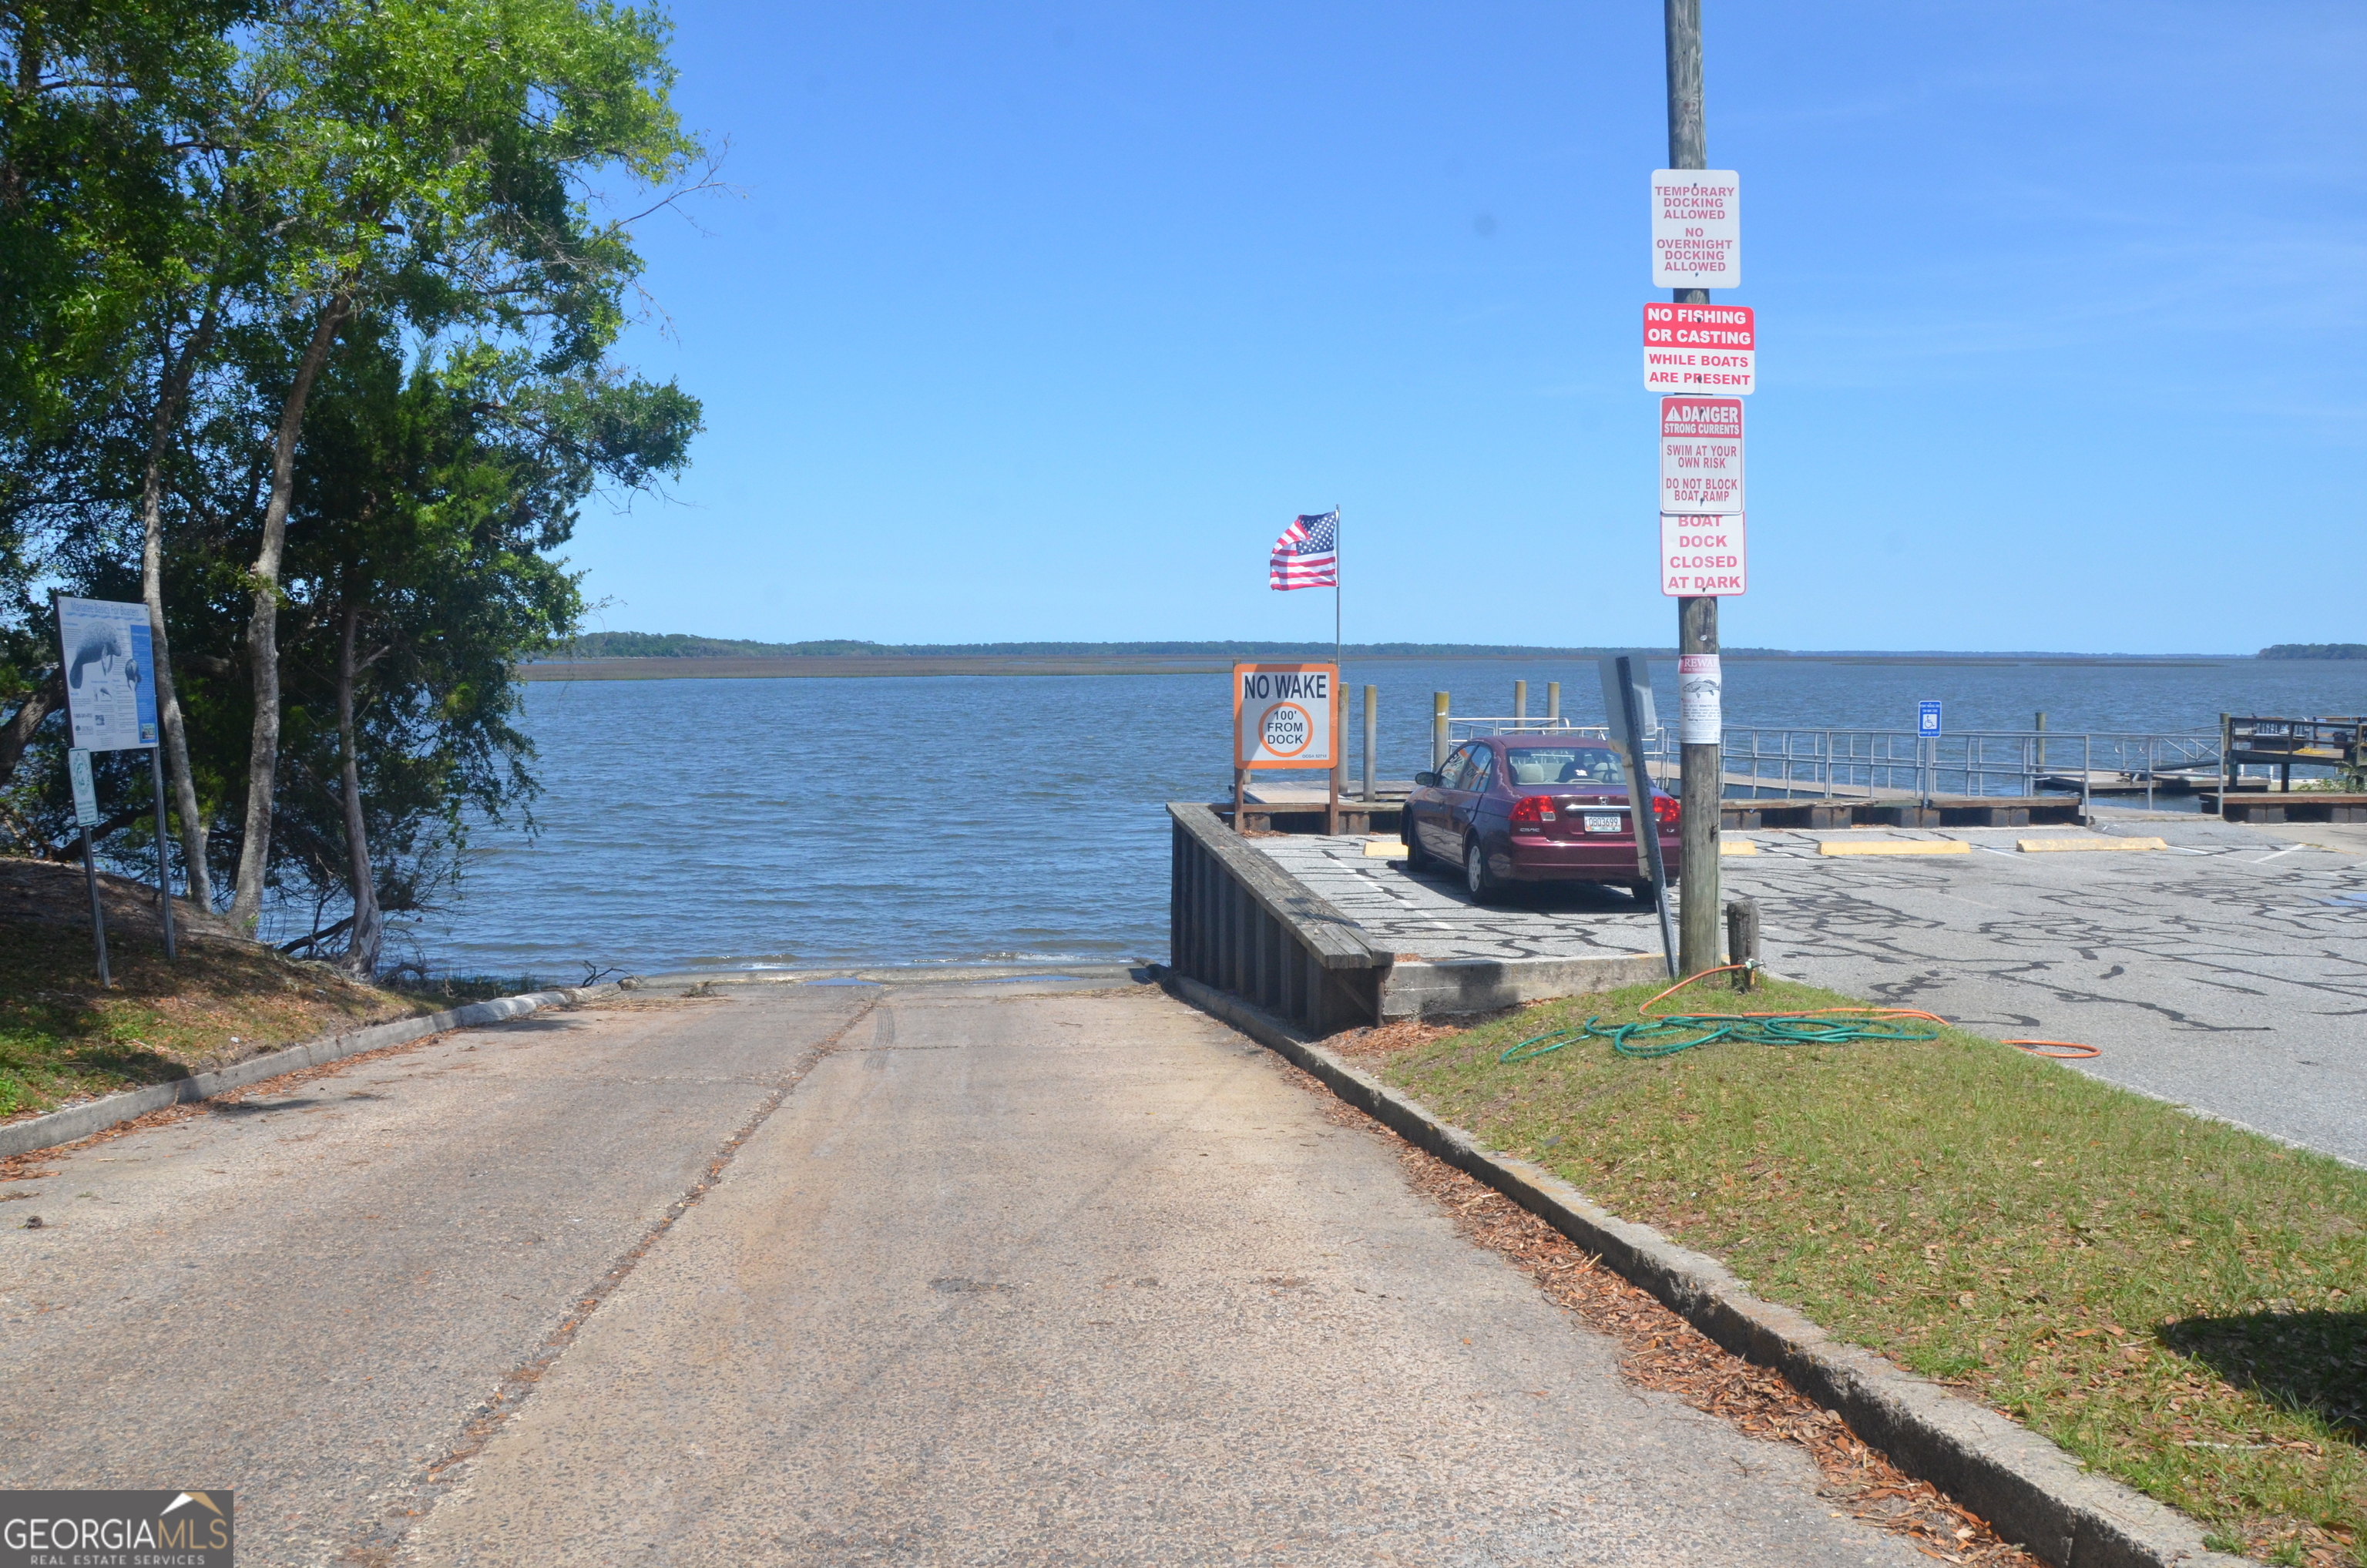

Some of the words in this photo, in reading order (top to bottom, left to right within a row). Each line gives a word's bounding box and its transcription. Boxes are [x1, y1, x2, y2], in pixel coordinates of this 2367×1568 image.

[1655, 186, 1735, 196] TEMPORARY
[1664, 198, 1724, 208] DOCKING
[1664, 210, 1725, 220] ALLOWED
[1685, 228, 1704, 237] NO
[1657, 239, 1732, 249] OVERNIGHT
[1665, 251, 1725, 260] DOCKING
[1664, 262, 1726, 272] ALLOWED
[1648, 308, 1672, 321] NO
[1677, 309, 1746, 325] FISHING
[1648, 328, 1672, 342] OR
[1676, 330, 1751, 345] CASTING
[1649, 353, 1696, 365] WHILE
[1701, 356, 1749, 367] BOATS
[1649, 372, 1679, 383] ARE
[1684, 373, 1750, 385] PRESENT
[1682, 406, 1739, 423] DANGER
[1664, 423, 1696, 434] STRONG
[1698, 424, 1739, 435] CURRENTS
[1667, 445, 1692, 456] SWIM
[1696, 445, 1707, 456] AT
[1711, 446, 1737, 457] YOUR
[1678, 457, 1700, 468] OWN
[1703, 457, 1726, 468] RISK
[1666, 478, 1679, 489] DO
[1683, 478, 1702, 489] NOT
[1706, 478, 1737, 490] BLOCK
[1674, 490, 1699, 501] BOAT
[1703, 491, 1729, 502] RAMP
[1678, 515, 1722, 527] BOAT
[1679, 535, 1727, 547] DOCK
[1670, 556, 1737, 568] CLOSED
[1668, 577, 1689, 588] AT
[1695, 576, 1741, 588] DARK
[71, 601, 93, 613] Manatee
[94, 603, 110, 614] Basics
[111, 605, 119, 615] For
[120, 606, 139, 616] Boaters
[1244, 675, 1269, 699] NO
[1275, 675, 1326, 698] WAKE
[1274, 710, 1297, 720] 100'
[1267, 723, 1303, 732] FROM
[1267, 735, 1303, 744] DOCK
